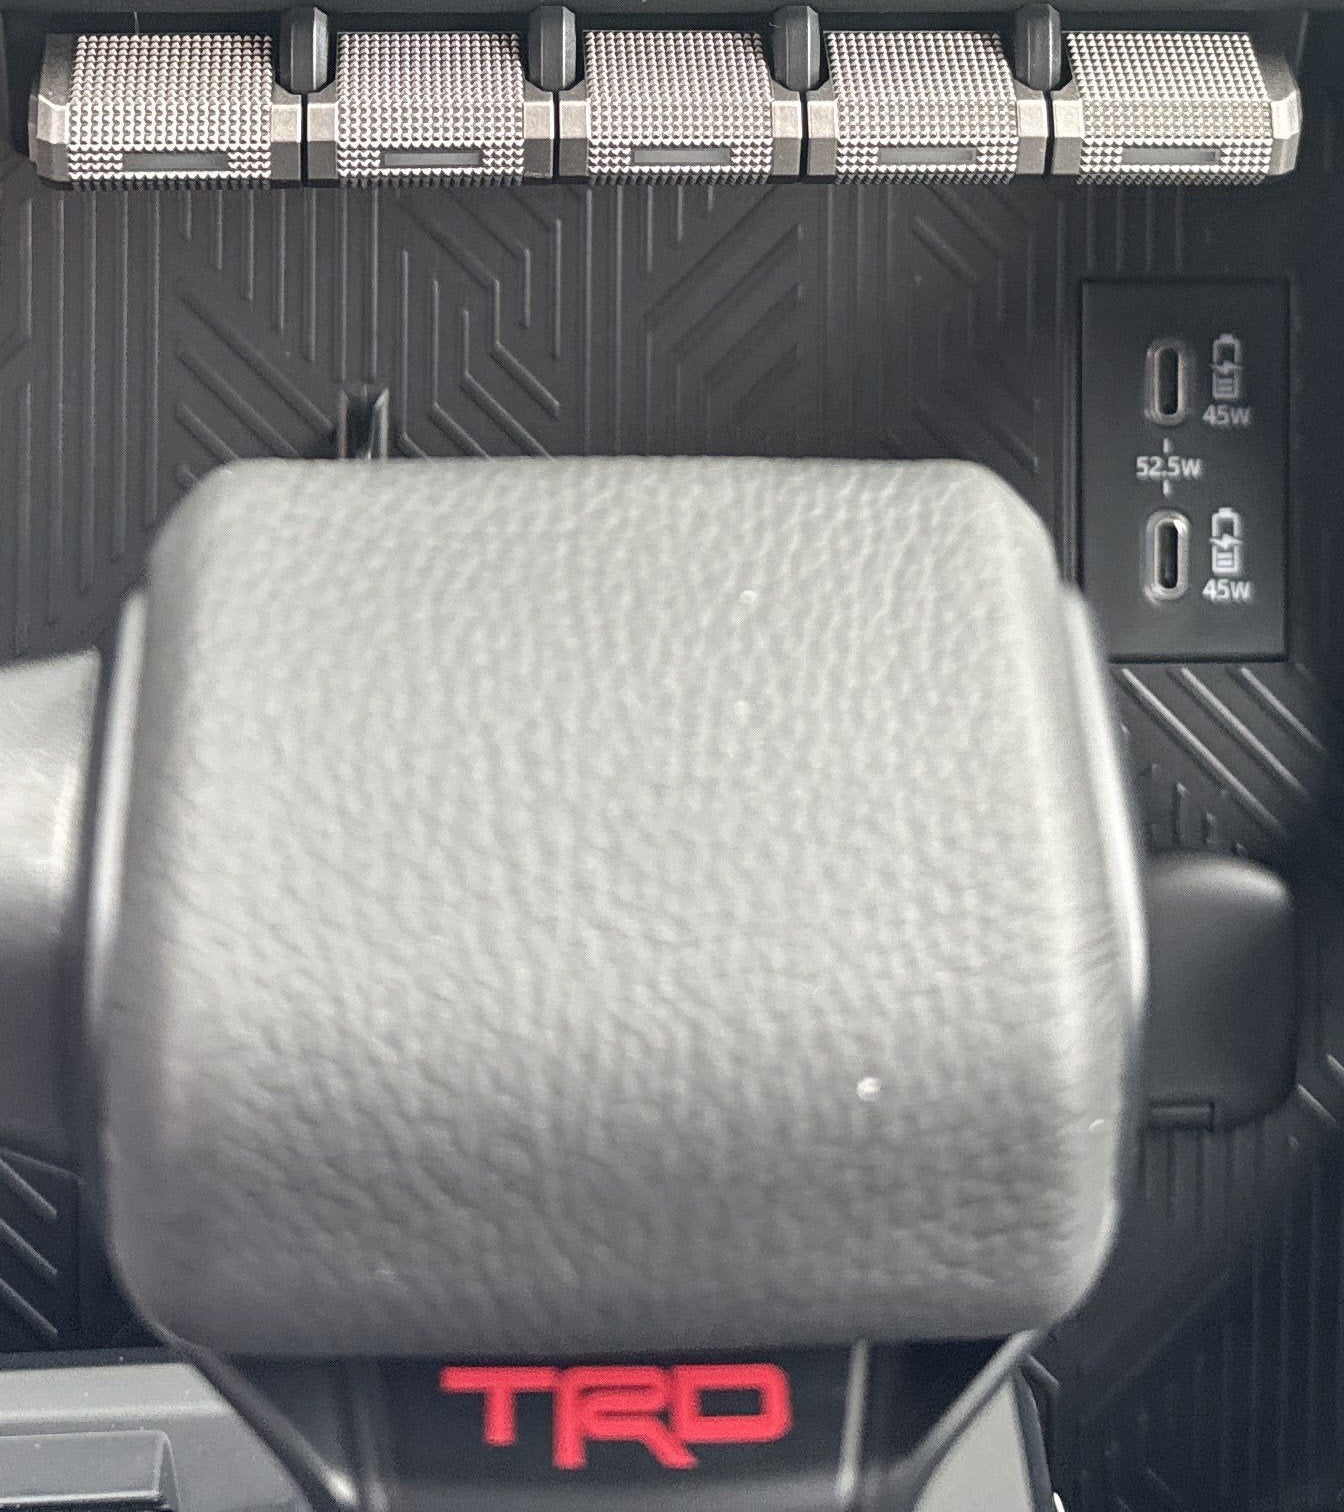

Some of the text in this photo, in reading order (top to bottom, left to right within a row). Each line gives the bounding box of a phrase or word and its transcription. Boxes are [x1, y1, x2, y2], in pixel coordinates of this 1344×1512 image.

[1202, 403, 1254, 426] 45W
[1135, 455, 1205, 479] 52.5W
[1201, 577, 1255, 604] 45W
[439, 1362, 794, 1470] TRD
